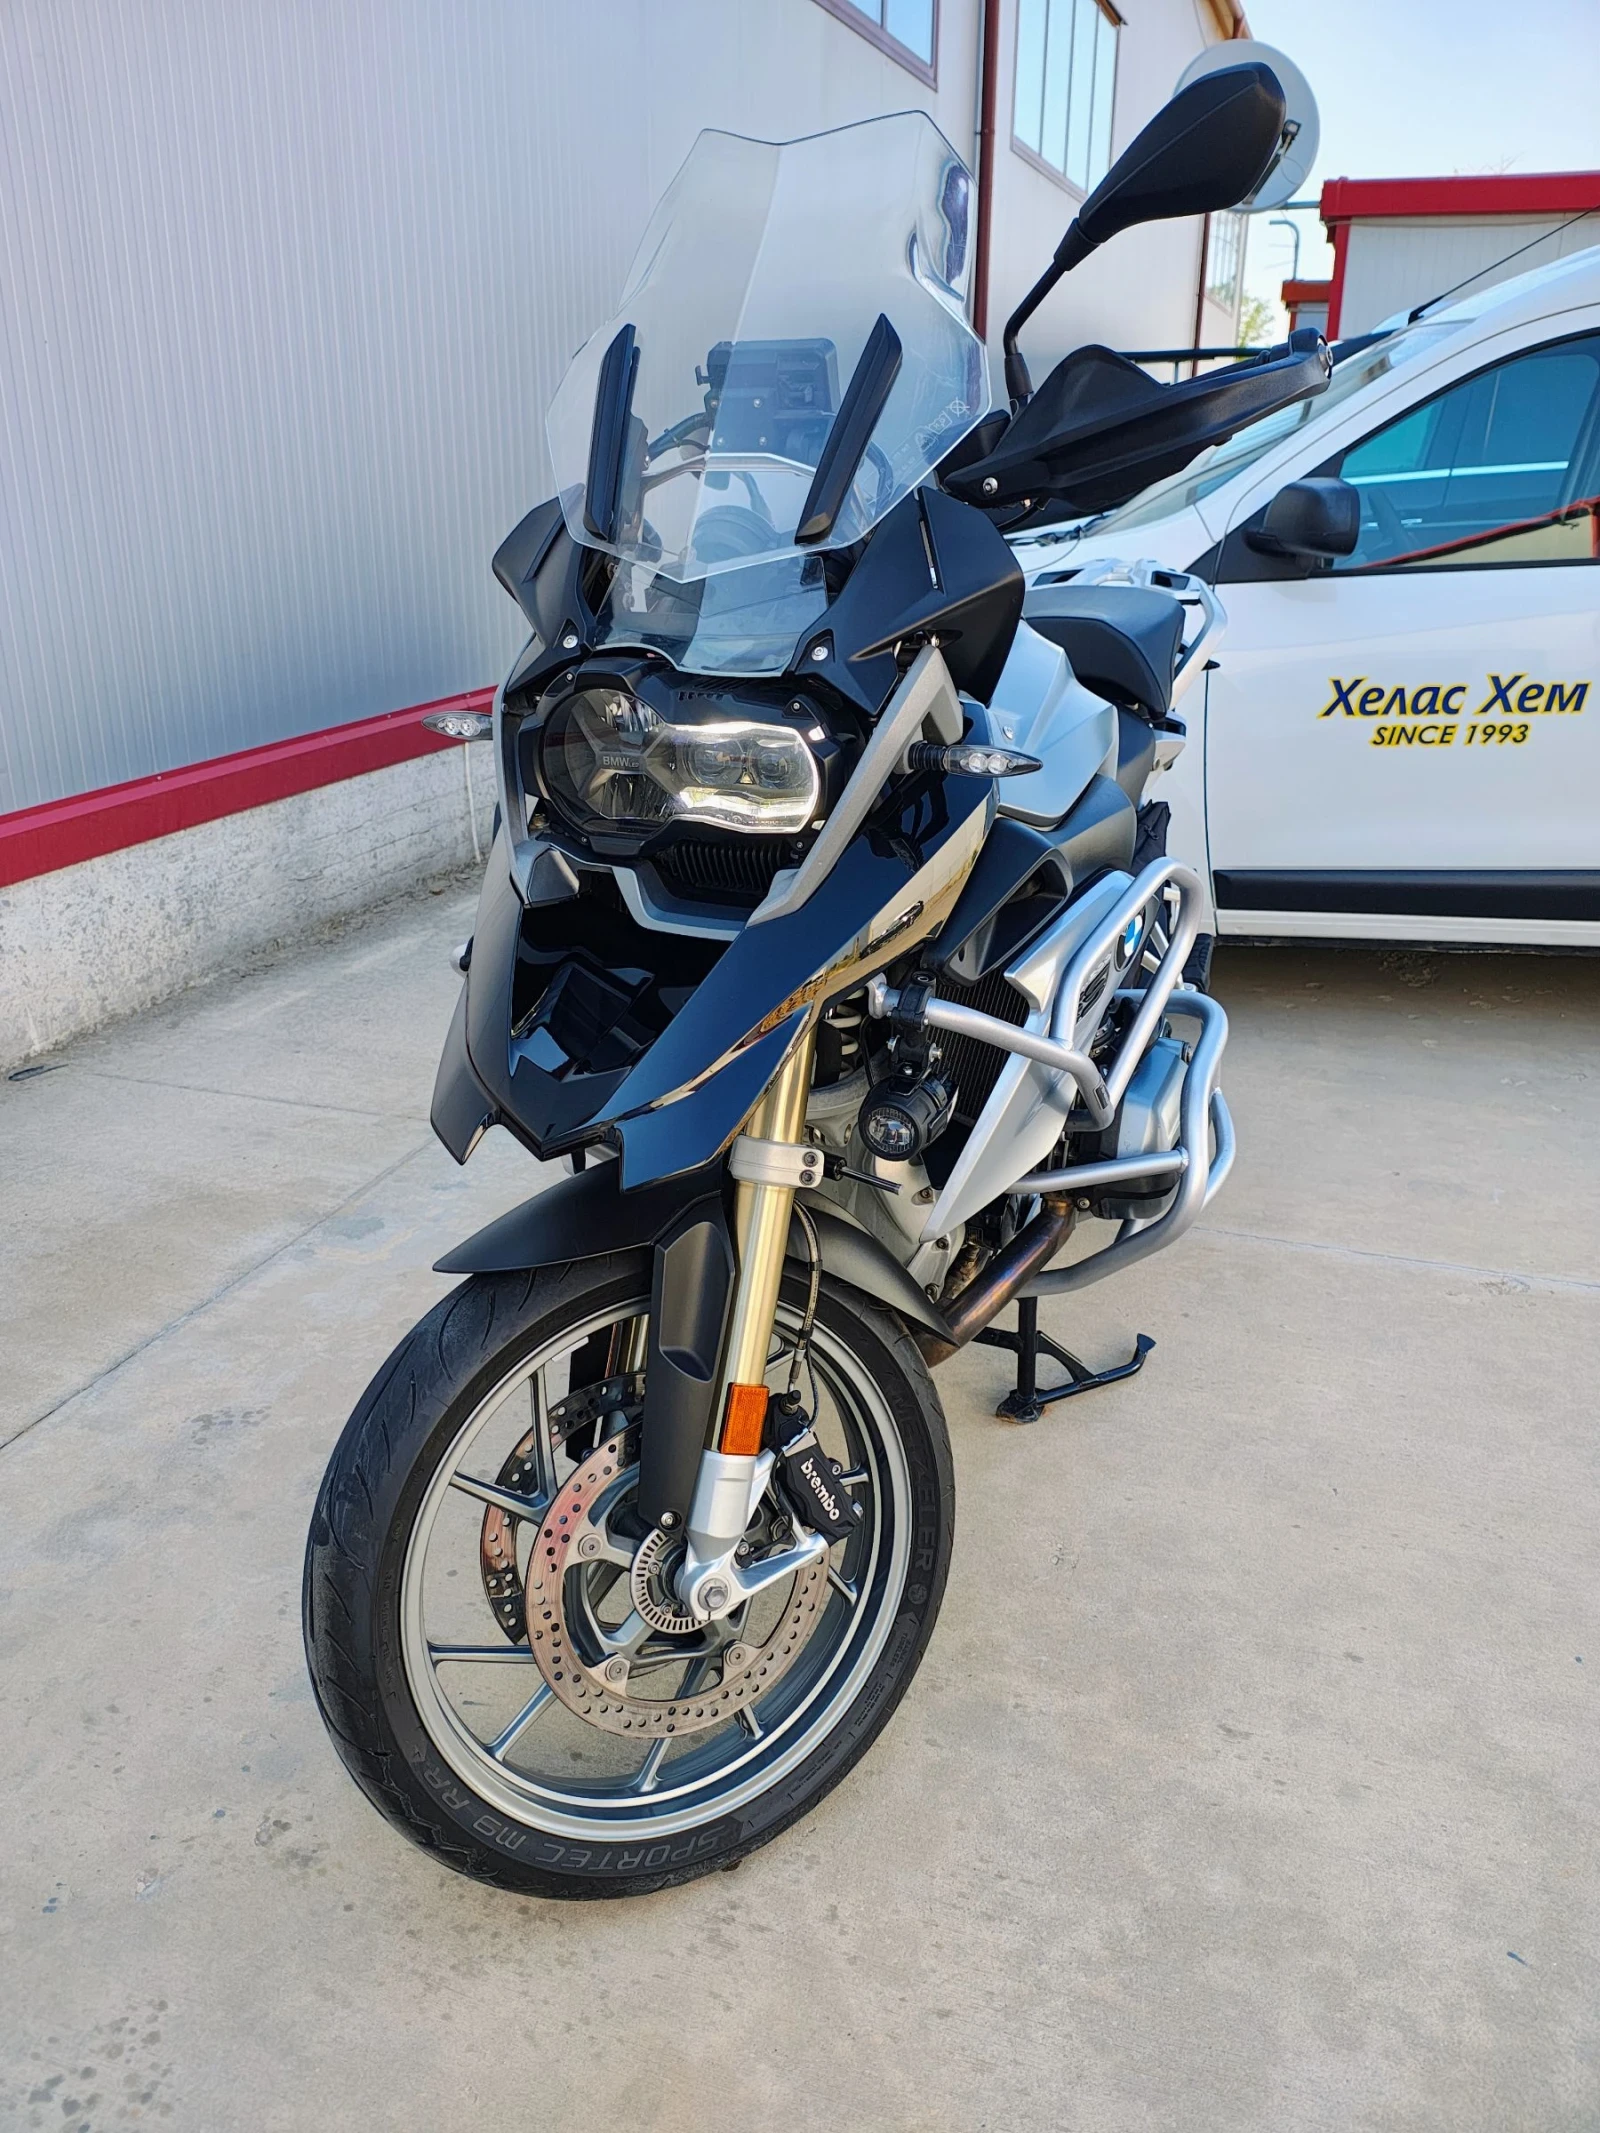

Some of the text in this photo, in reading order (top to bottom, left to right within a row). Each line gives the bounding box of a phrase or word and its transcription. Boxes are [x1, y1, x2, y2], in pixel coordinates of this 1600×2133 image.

[1319, 673, 1591, 718] Хелас Хем
[1371, 723, 1530, 746] SINCE 1993
[603, 756, 629, 767] BMW
[800, 1457, 840, 1520] brembo
[423, 1766, 471, 1811] RR
[534, 1824, 725, 1871] SPORTEC
